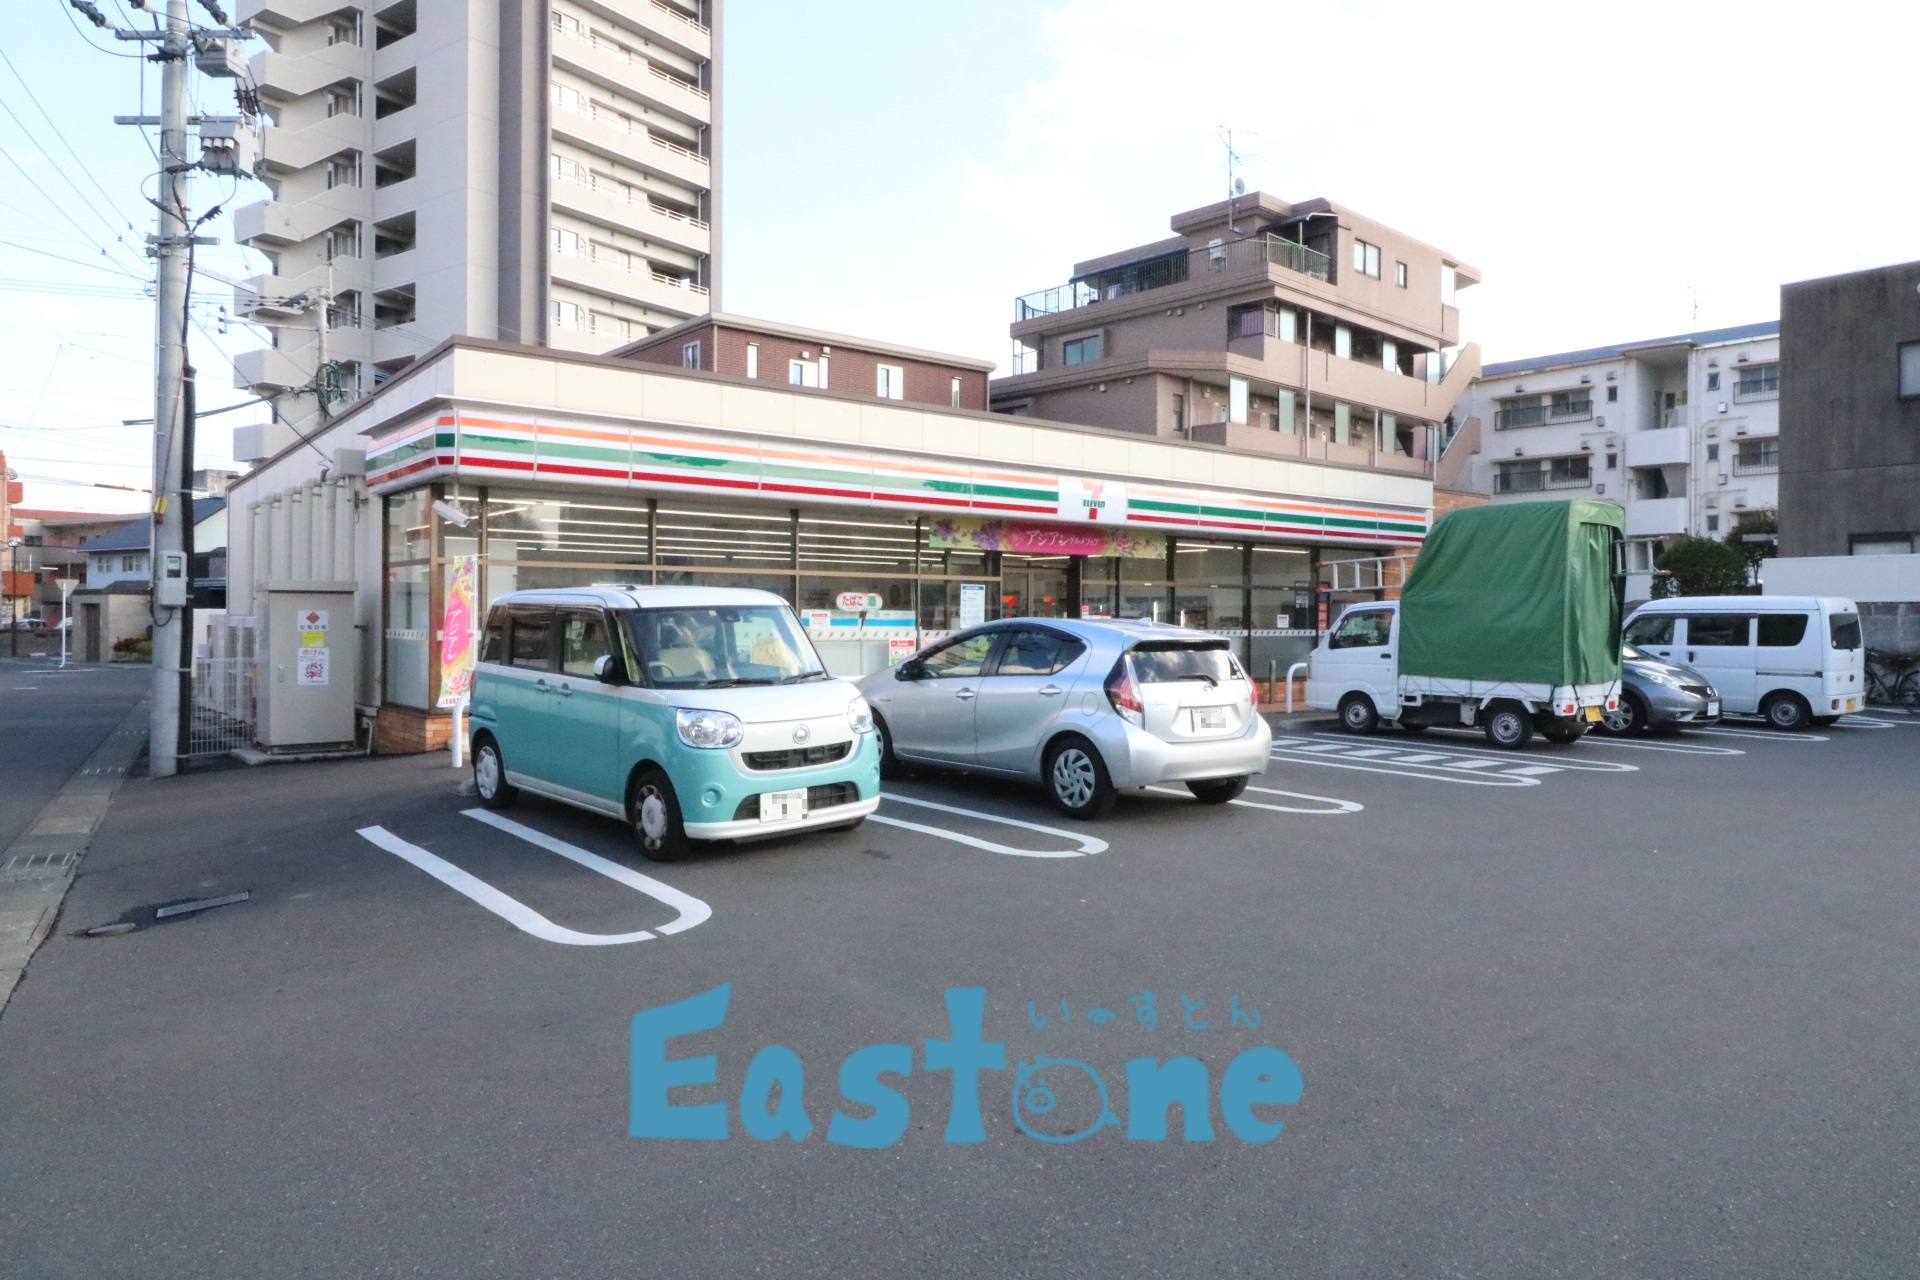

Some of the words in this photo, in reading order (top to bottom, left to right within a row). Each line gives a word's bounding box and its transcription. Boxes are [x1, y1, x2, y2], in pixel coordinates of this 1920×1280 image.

[842, 595, 864, 606] たばこ
[446, 609, 463, 660] アジアン
